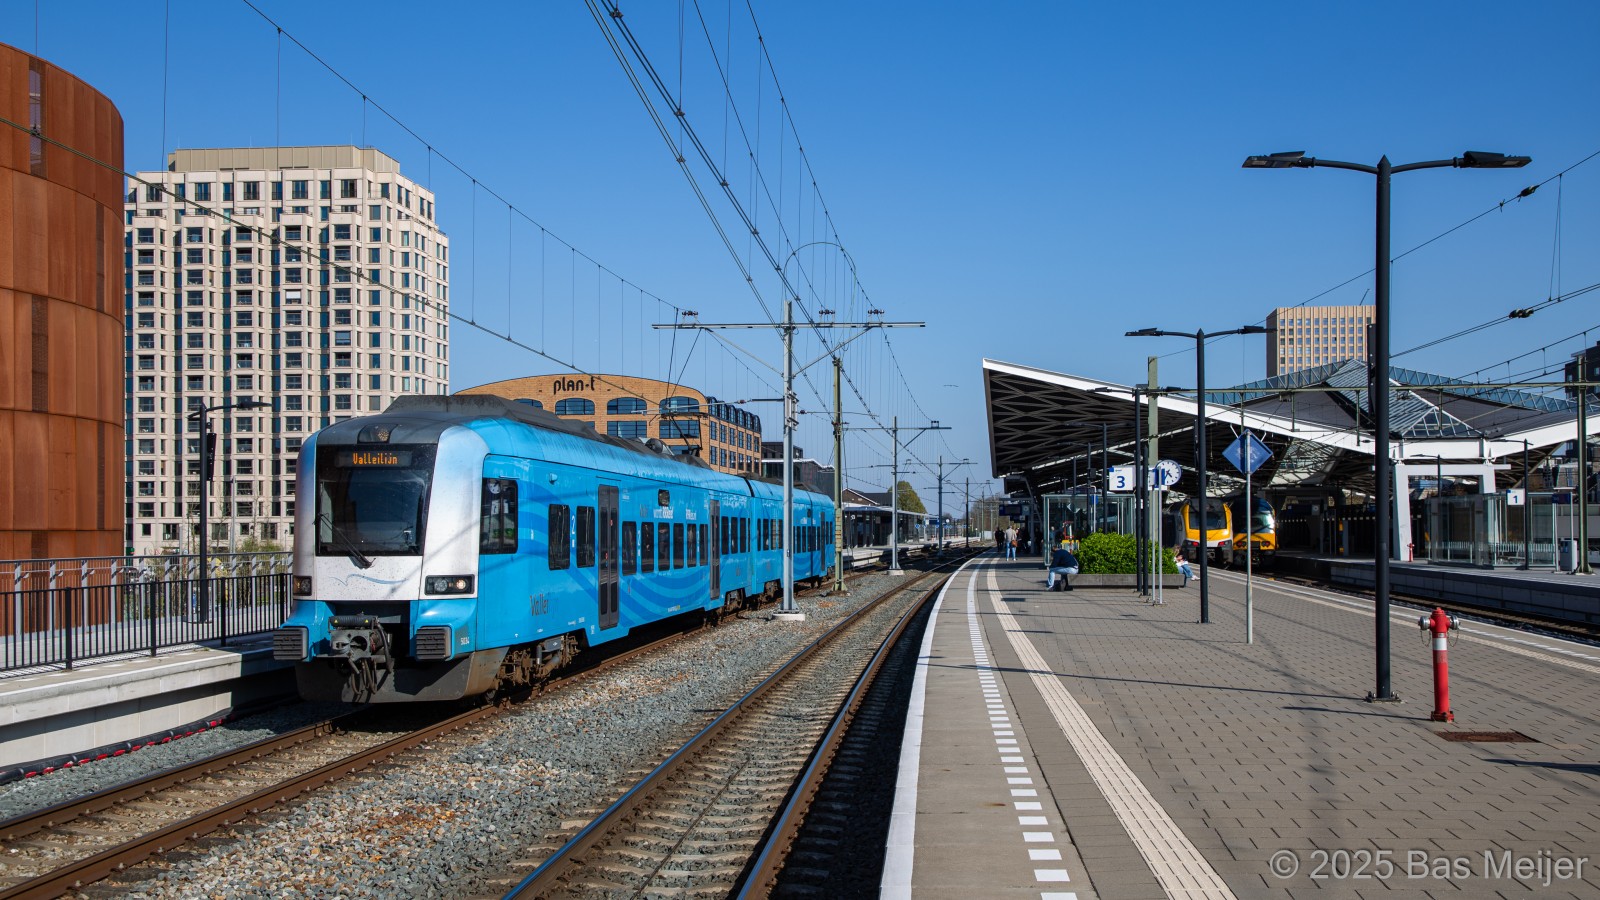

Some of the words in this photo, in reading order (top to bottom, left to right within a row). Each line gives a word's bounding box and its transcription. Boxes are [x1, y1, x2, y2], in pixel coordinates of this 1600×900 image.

[353, 452, 398, 465] Valleilijn
[1116, 475, 1126, 489] 3
[1512, 495, 1518, 504] 1
[571, 515, 576, 535] 2
